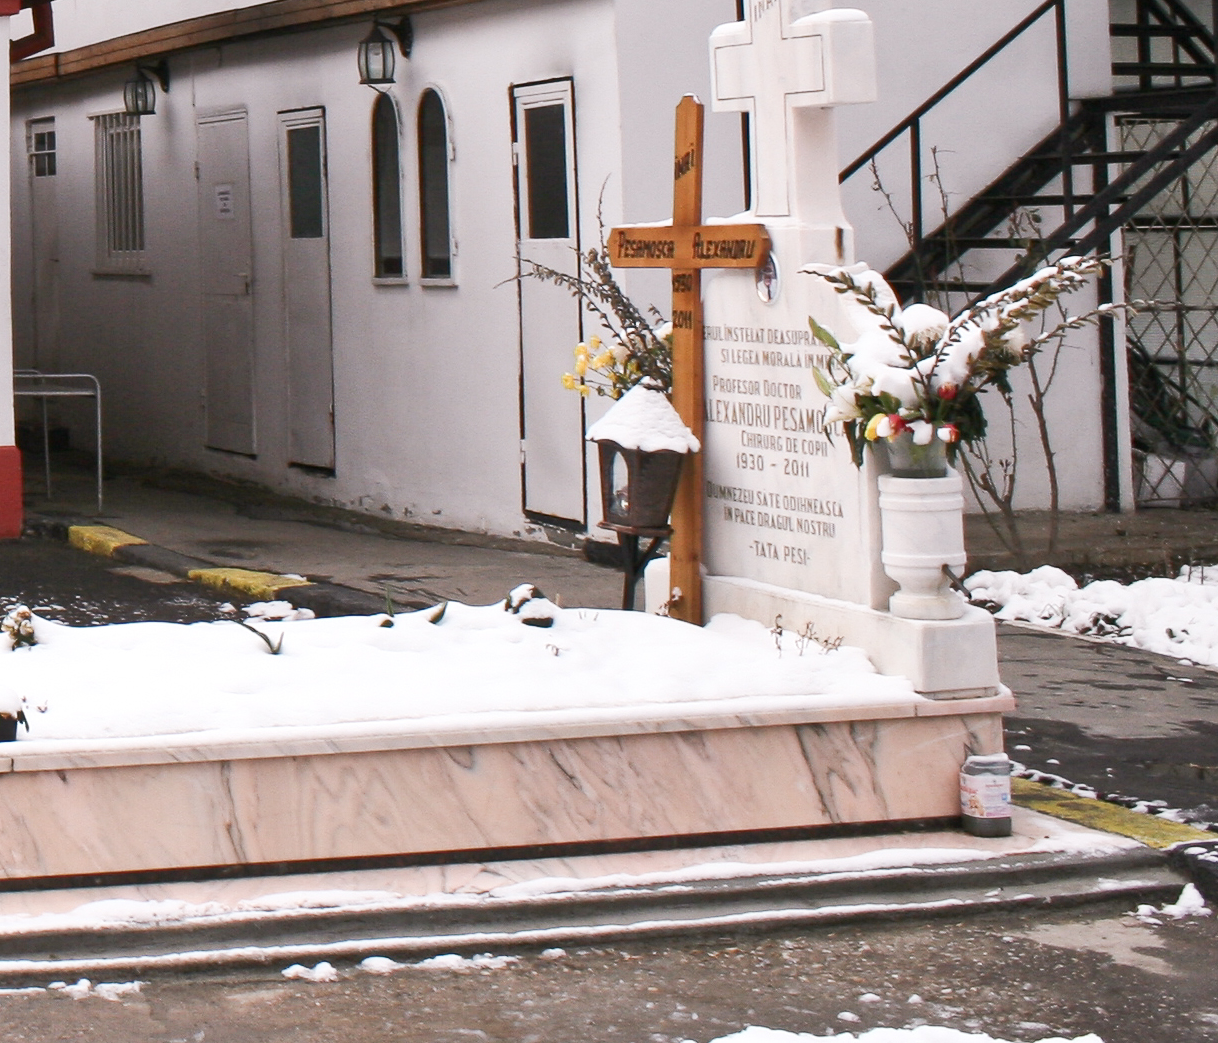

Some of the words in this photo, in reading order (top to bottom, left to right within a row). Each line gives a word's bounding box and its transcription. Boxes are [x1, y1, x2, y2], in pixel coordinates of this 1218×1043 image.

[617, 230, 675, 259] PESAMOSCA
[692, 231, 756, 260] ALEXANDRU
[673, 309, 693, 329] 2011
[712, 374, 761, 395] PROFESOR
[763, 379, 803, 400] DOCTOR
[741, 429, 783, 452] CHIRURG
[785, 436, 799, 454] DE
[801, 438, 828, 458] COPII
[736, 452, 764, 472] 1930
[783, 458, 810, 478] 2011
[705, 480, 755, 505] DUMNEZEU
[735, 507, 756, 526] PACE
[796, 517, 836, 539] NOSTRU
